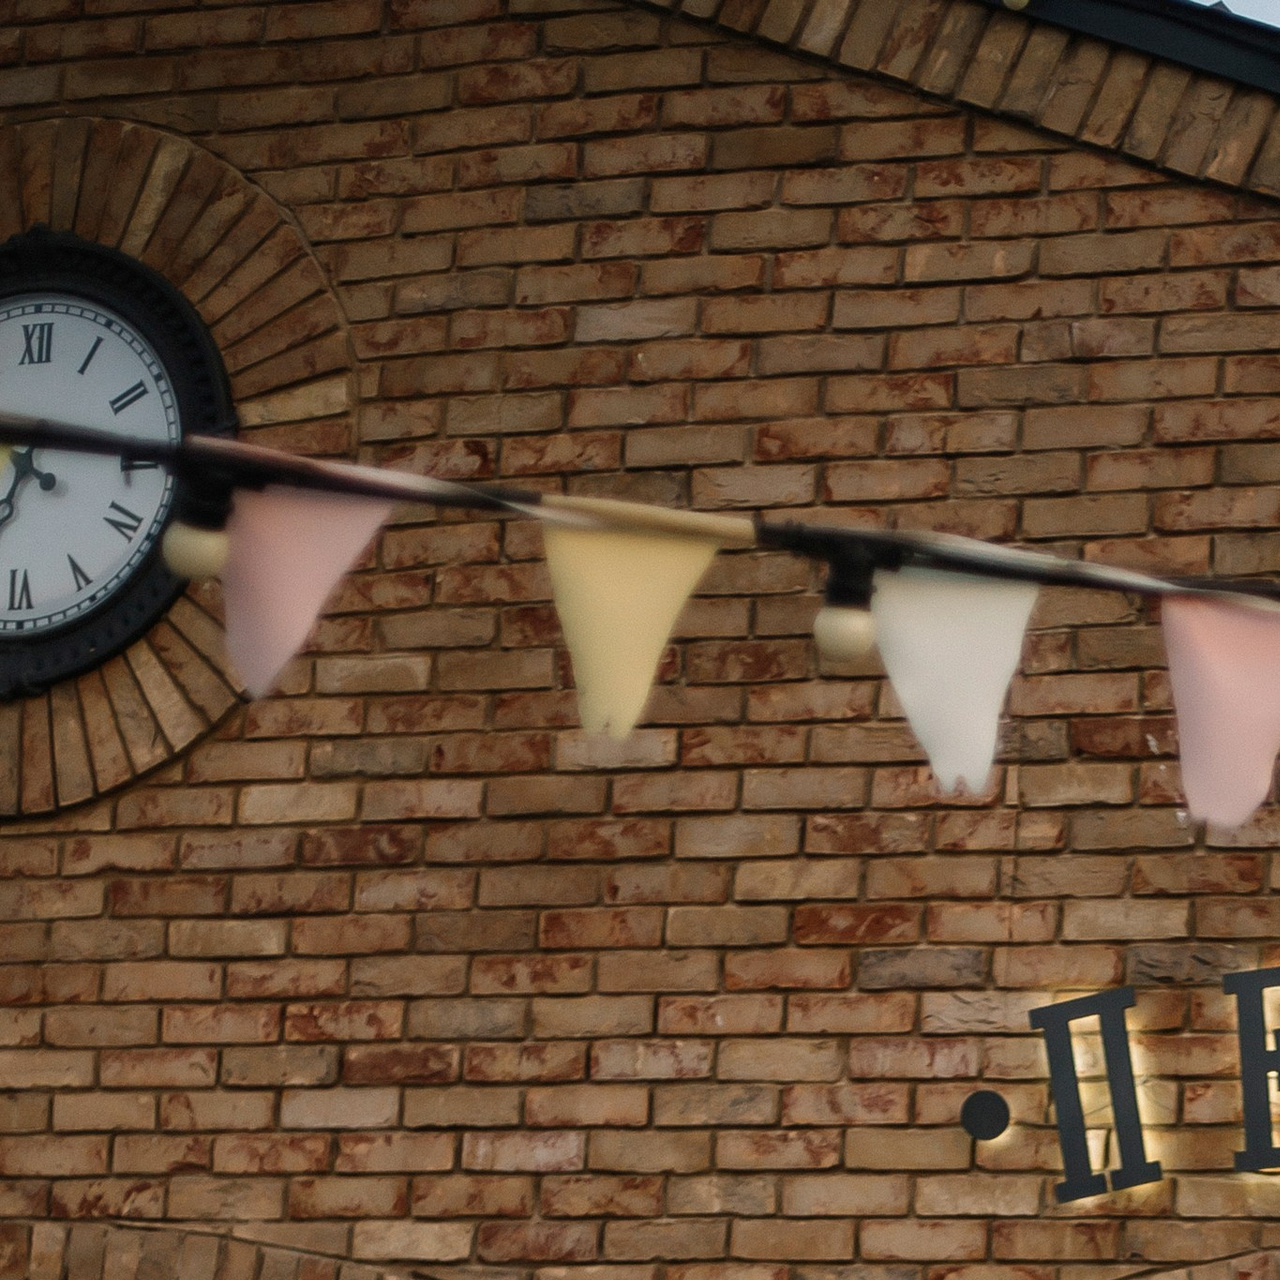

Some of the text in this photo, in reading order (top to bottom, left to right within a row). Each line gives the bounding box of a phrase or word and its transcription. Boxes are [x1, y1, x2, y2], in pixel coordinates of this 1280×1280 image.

[18, 322, 54, 366] XII
[77, 335, 104, 375] I
[109, 379, 149, 416] II
[103, 501, 144, 543] IV
[8, 568, 34, 611] VI
[67, 553, 93, 592] V
